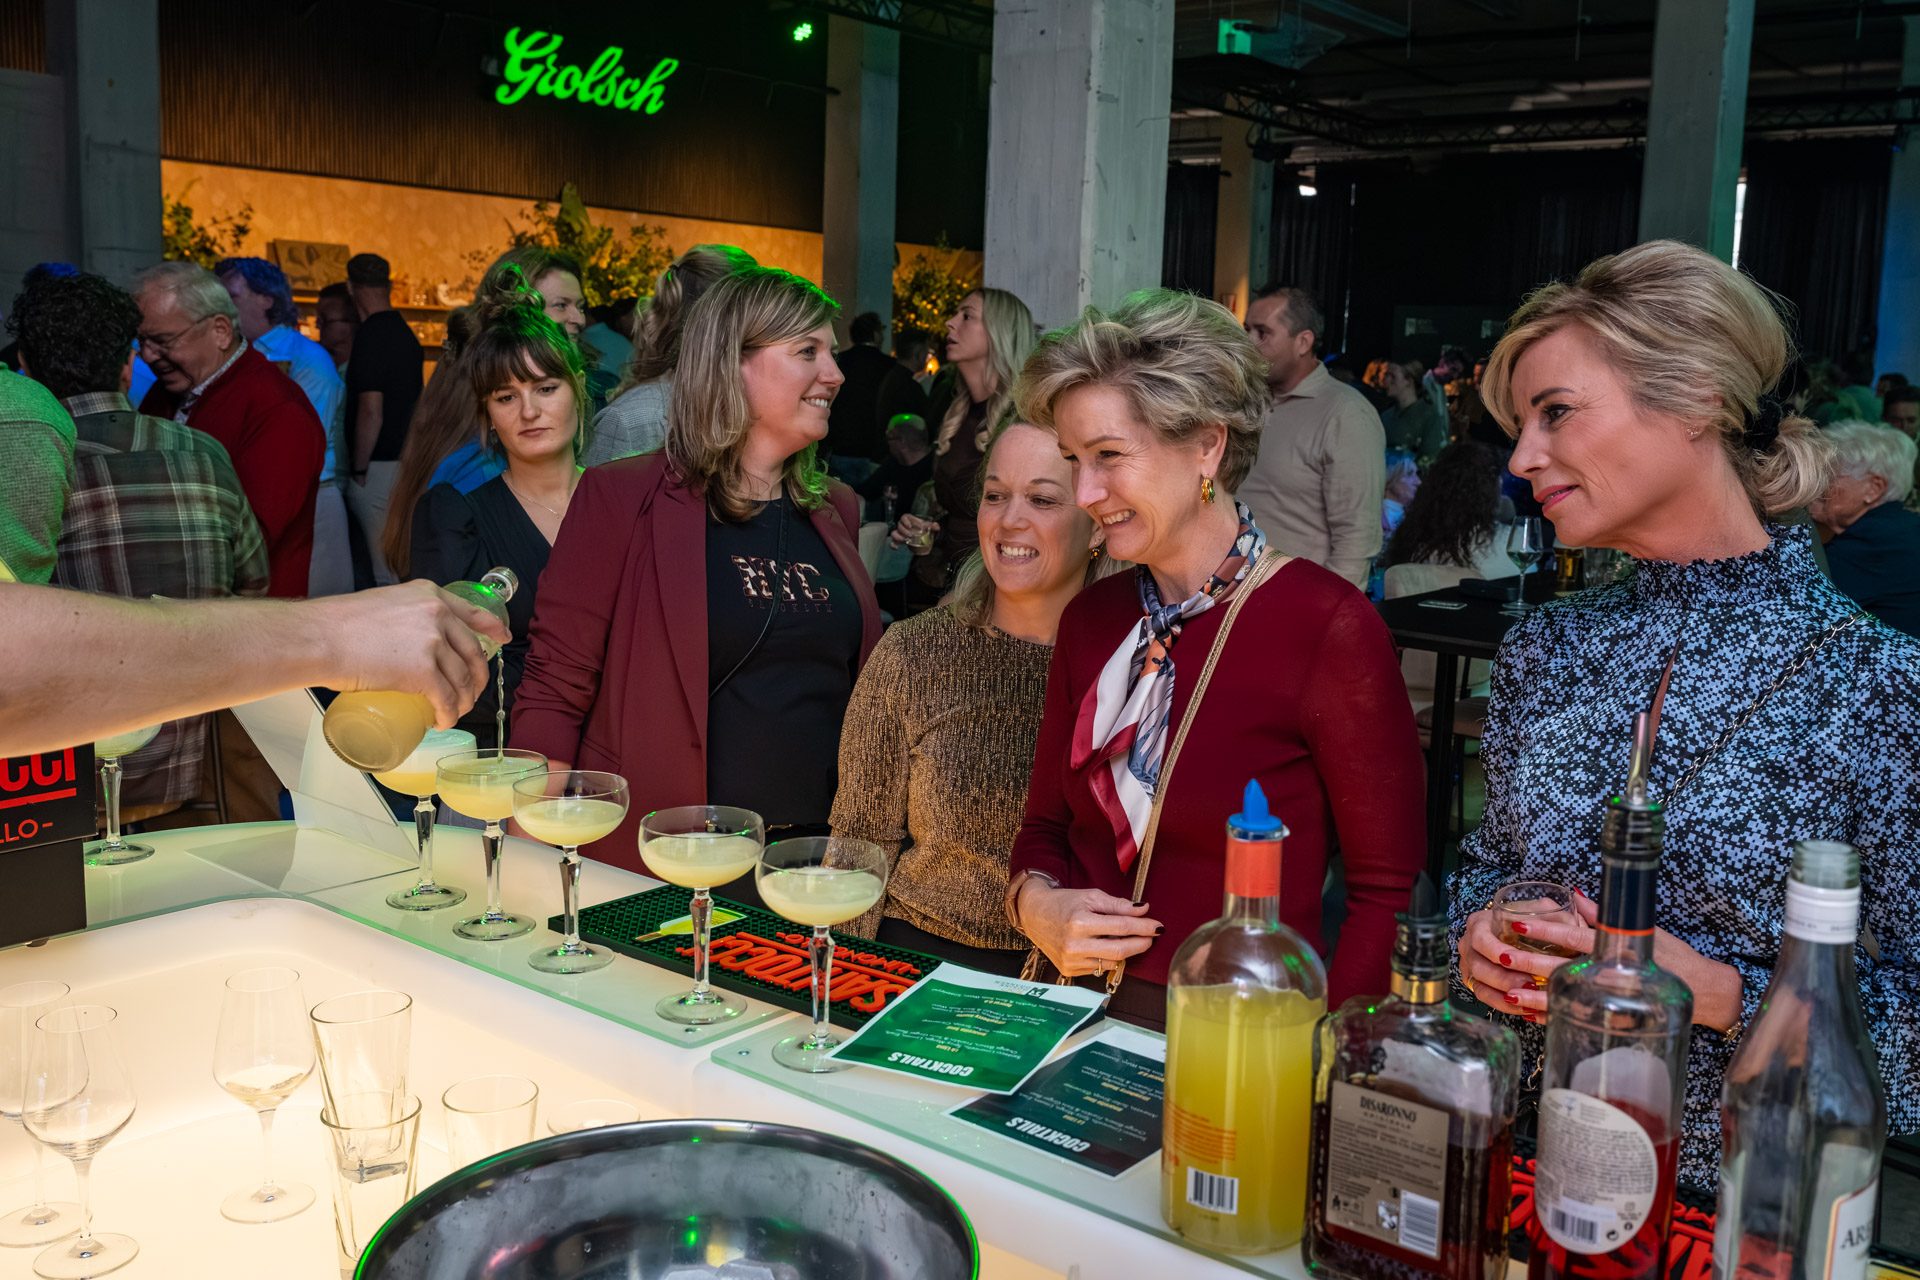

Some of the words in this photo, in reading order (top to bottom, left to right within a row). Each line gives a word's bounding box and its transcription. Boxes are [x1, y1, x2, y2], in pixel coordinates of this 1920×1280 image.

[495, 26, 679, 115] Grolsch
[887, 1051, 974, 1078] COCKTAILS
[1005, 1116, 1091, 1153] COCKTAILS
